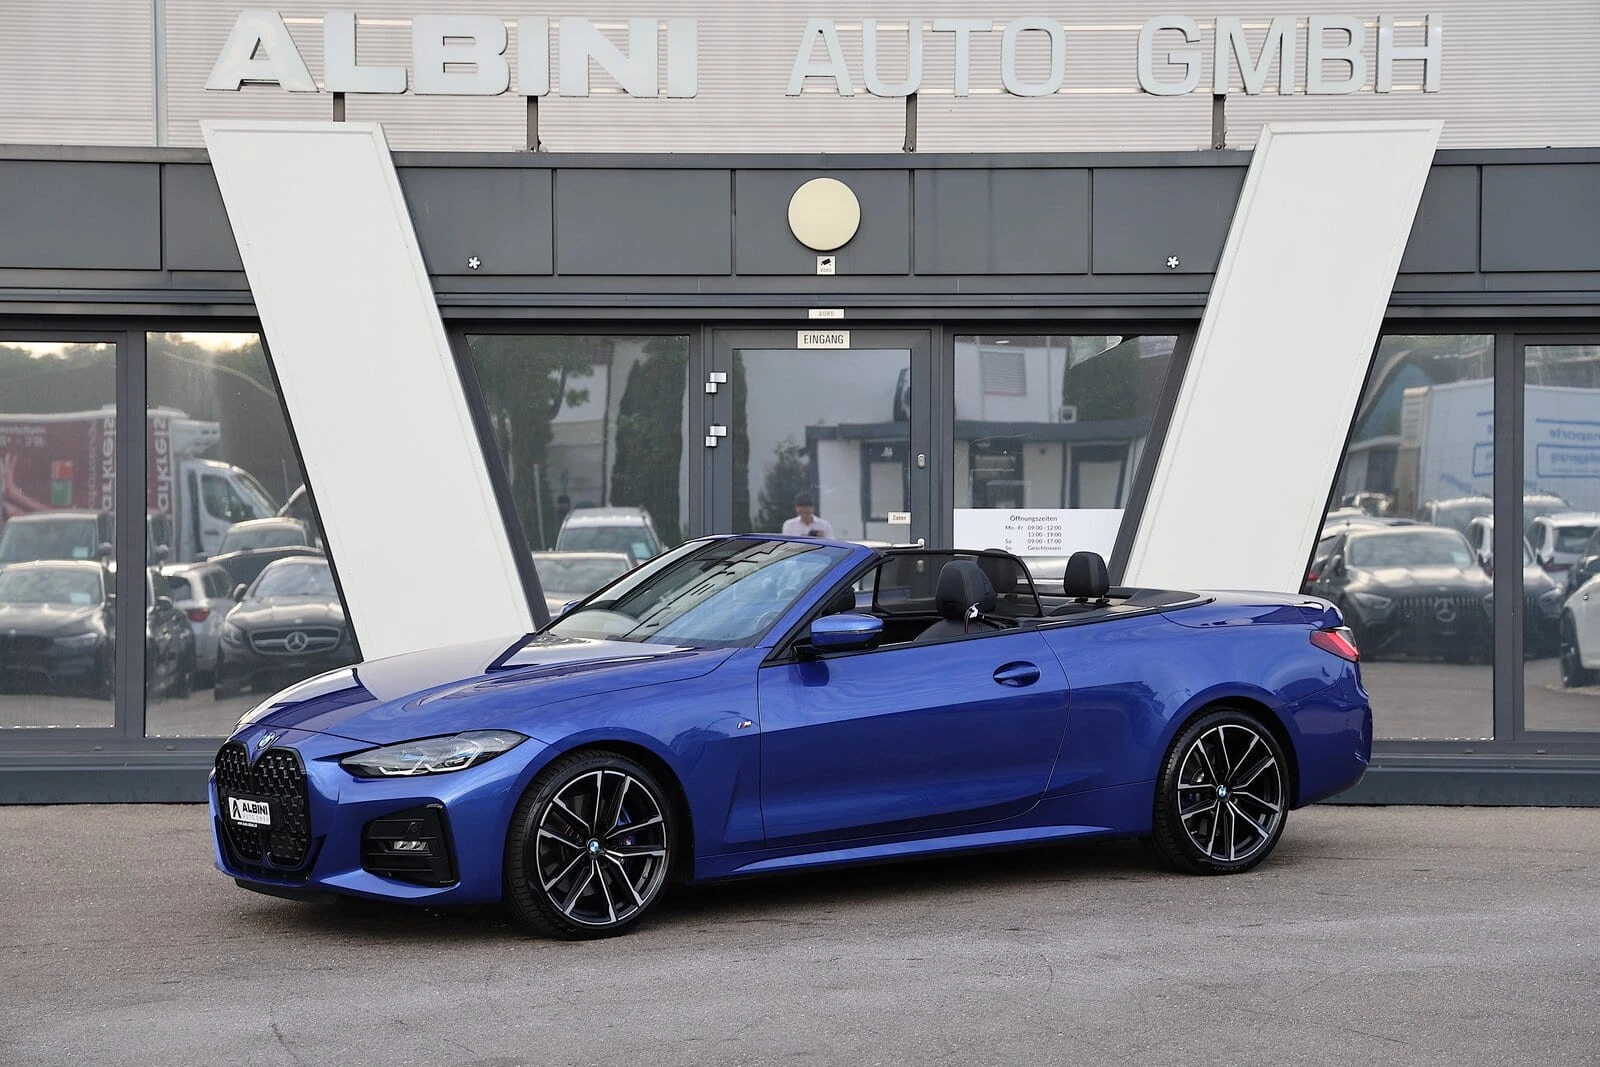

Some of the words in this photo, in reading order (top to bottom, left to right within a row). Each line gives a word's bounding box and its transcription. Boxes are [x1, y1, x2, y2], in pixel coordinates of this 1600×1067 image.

[204, 10, 699, 98] ALBINI
[785, 16, 1067, 97] AUTO
[1136, 14, 1443, 95] GMBH
[803, 334, 844, 345] EINGANG
[242, 803, 268, 815] ALBINI
